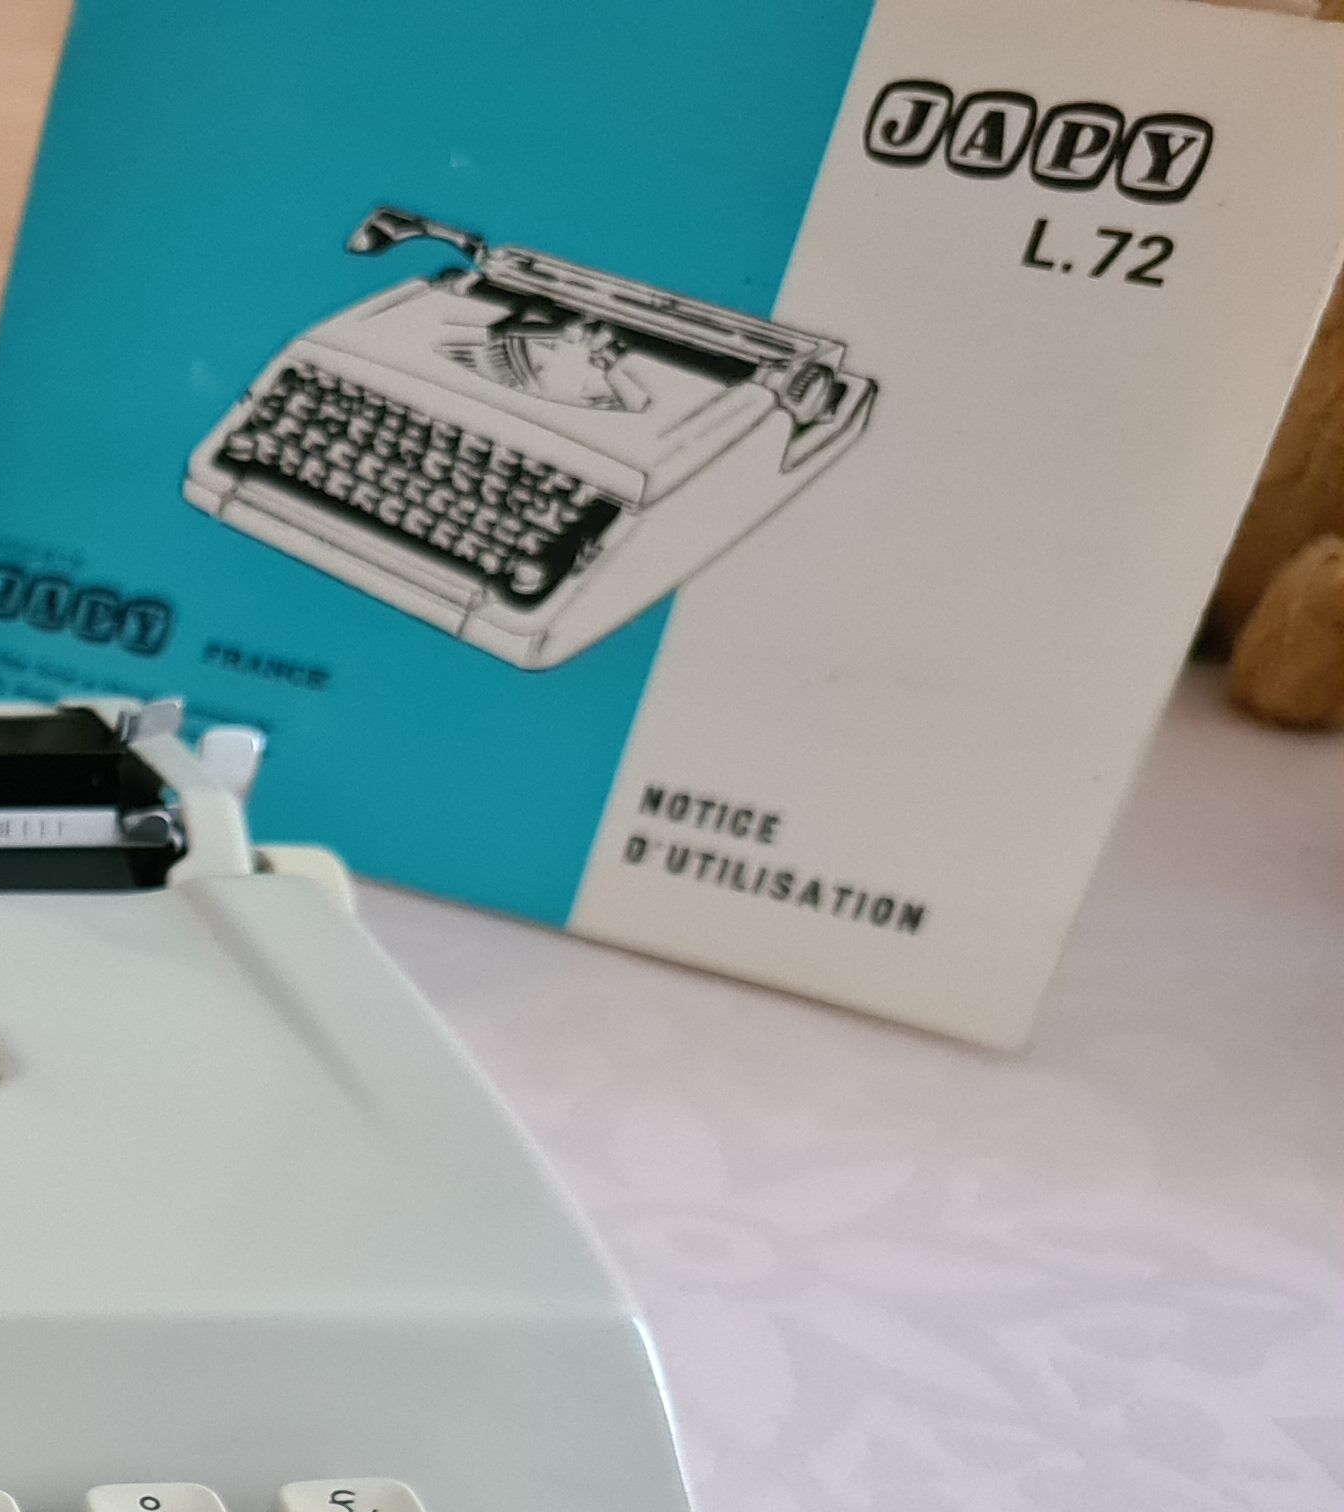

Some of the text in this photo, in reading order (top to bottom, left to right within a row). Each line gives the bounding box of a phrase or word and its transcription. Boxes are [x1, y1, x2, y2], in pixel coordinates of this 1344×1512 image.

[865, 80, 1213, 203] JAPY
[1021, 217, 1174, 287] L.72
[641, 786, 781, 844] NOTICE
